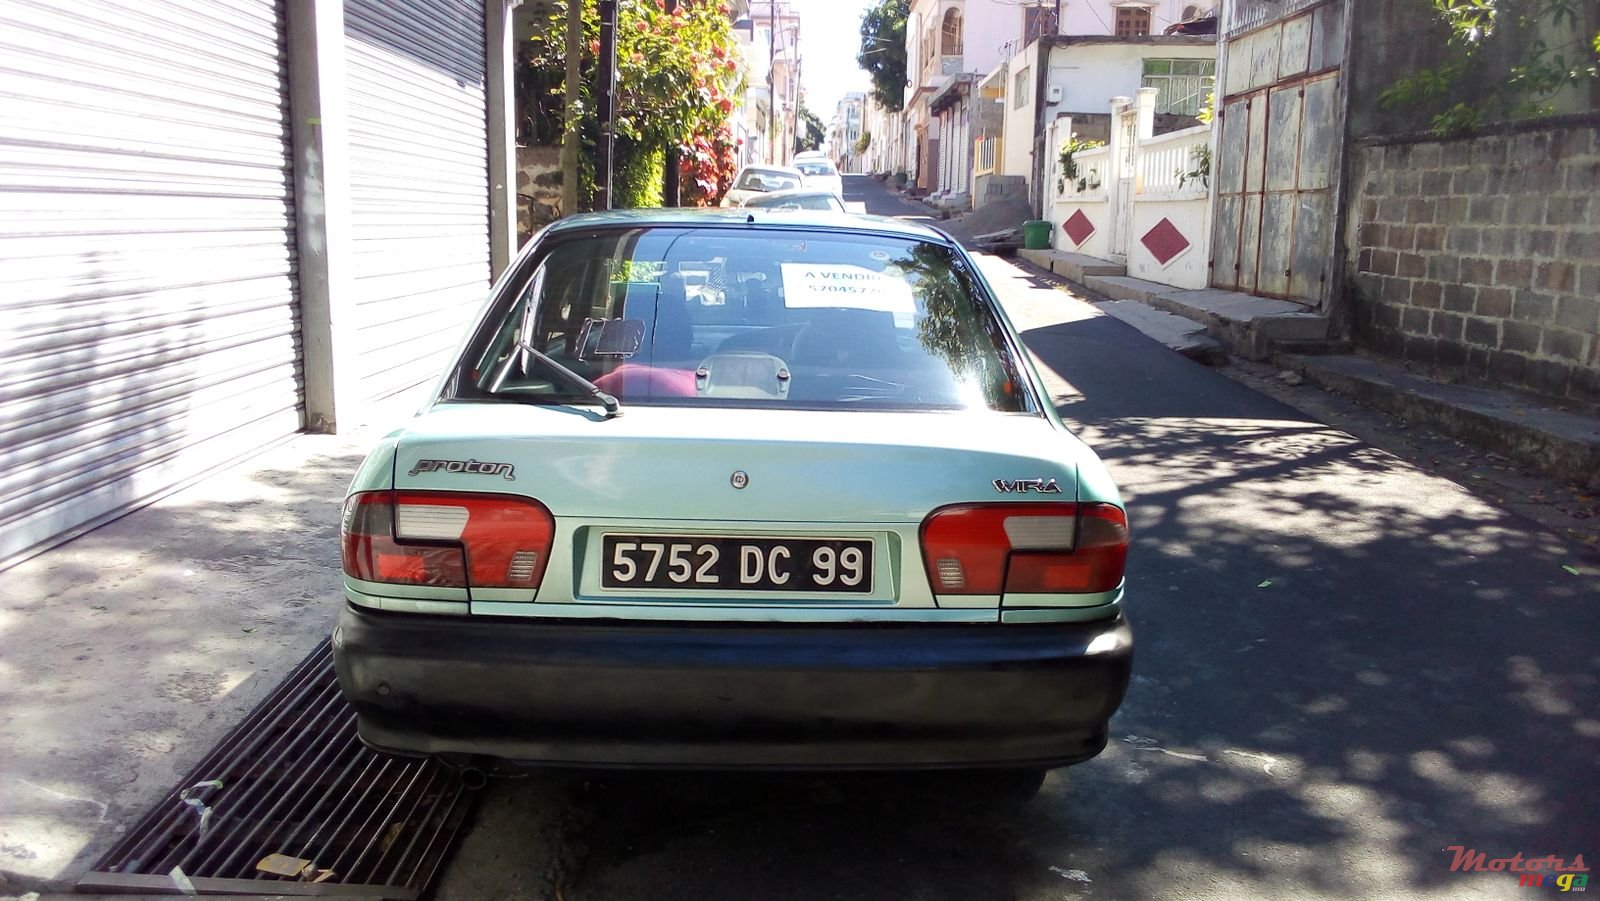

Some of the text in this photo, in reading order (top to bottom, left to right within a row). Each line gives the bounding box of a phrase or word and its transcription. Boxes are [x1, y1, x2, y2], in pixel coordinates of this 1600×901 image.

[805, 271, 816, 279] A
[808, 284, 882, 293] 570457
[408, 459, 516, 481] proton
[992, 478, 1063, 493] WIRA
[612, 543, 864, 586] 5752 DC 99
